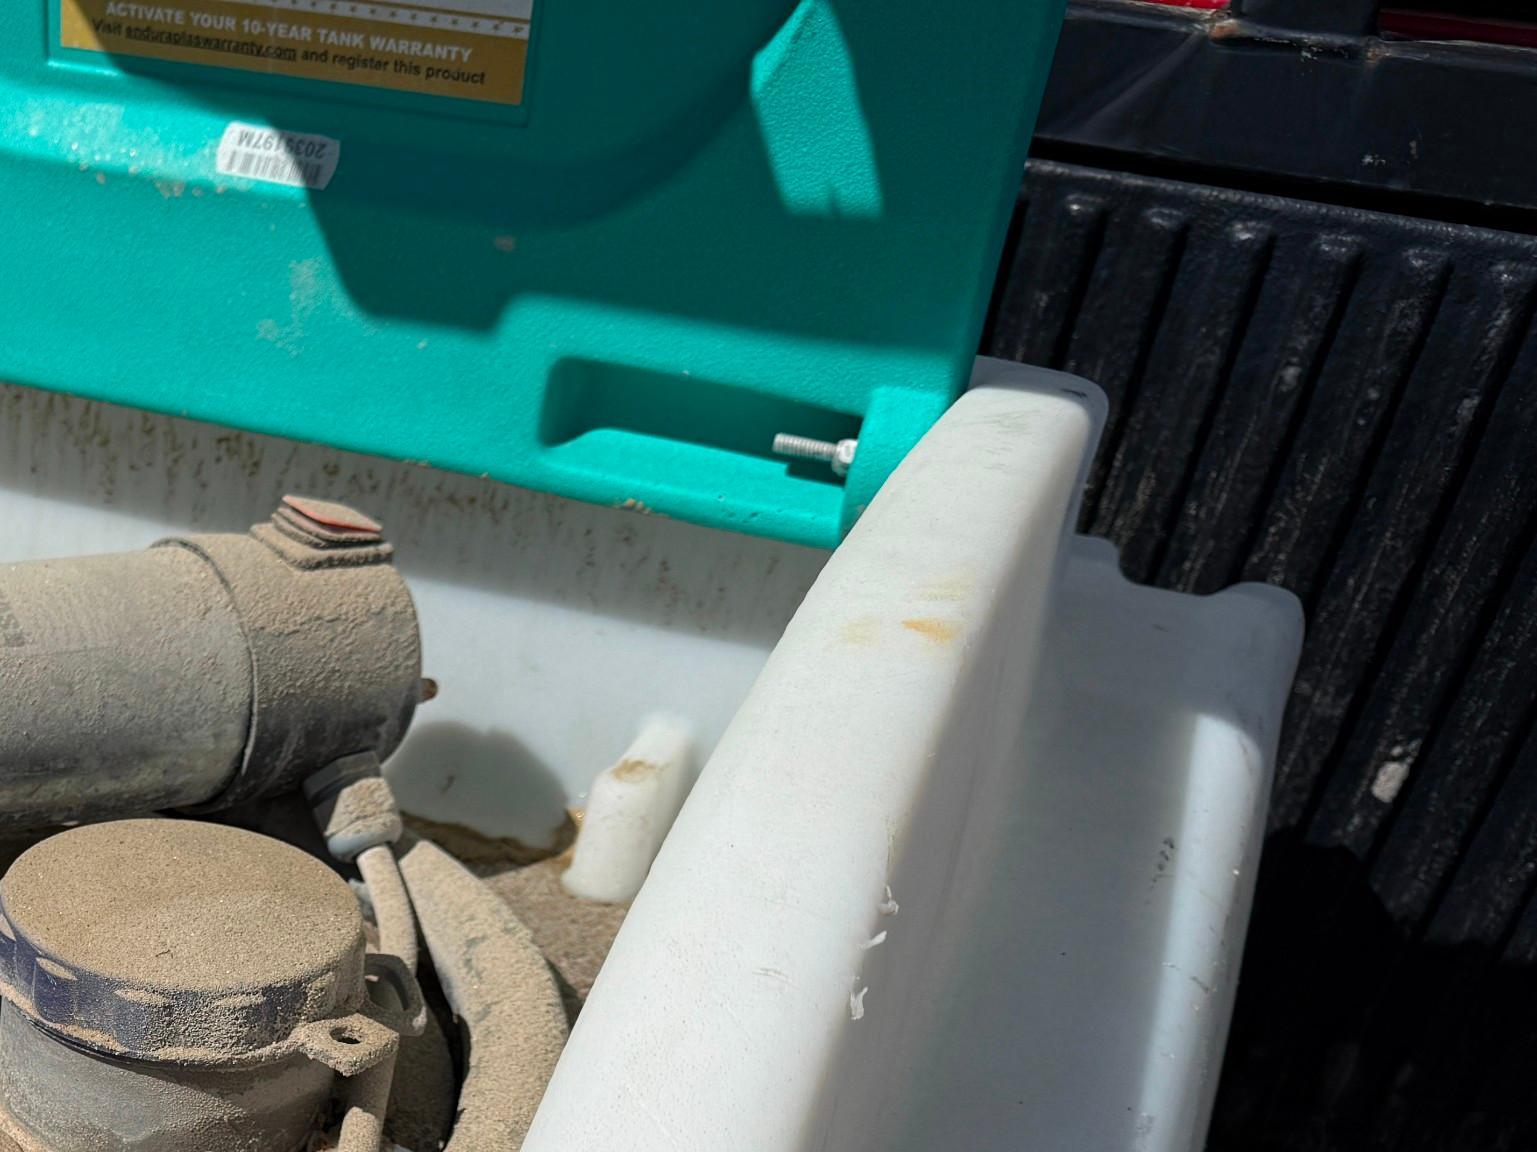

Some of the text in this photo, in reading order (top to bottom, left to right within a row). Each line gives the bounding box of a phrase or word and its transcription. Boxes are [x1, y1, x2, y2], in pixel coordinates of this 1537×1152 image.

[92, 18, 122, 36] Visit
[301, 48, 327, 65] and
[332, 52, 390, 72] register
[393, 59, 421, 77] this
[425, 66, 486, 86] product
[105, 1, 473, 64] ACTIVATE YOUR 10-YEAR TANK WARRANTY
